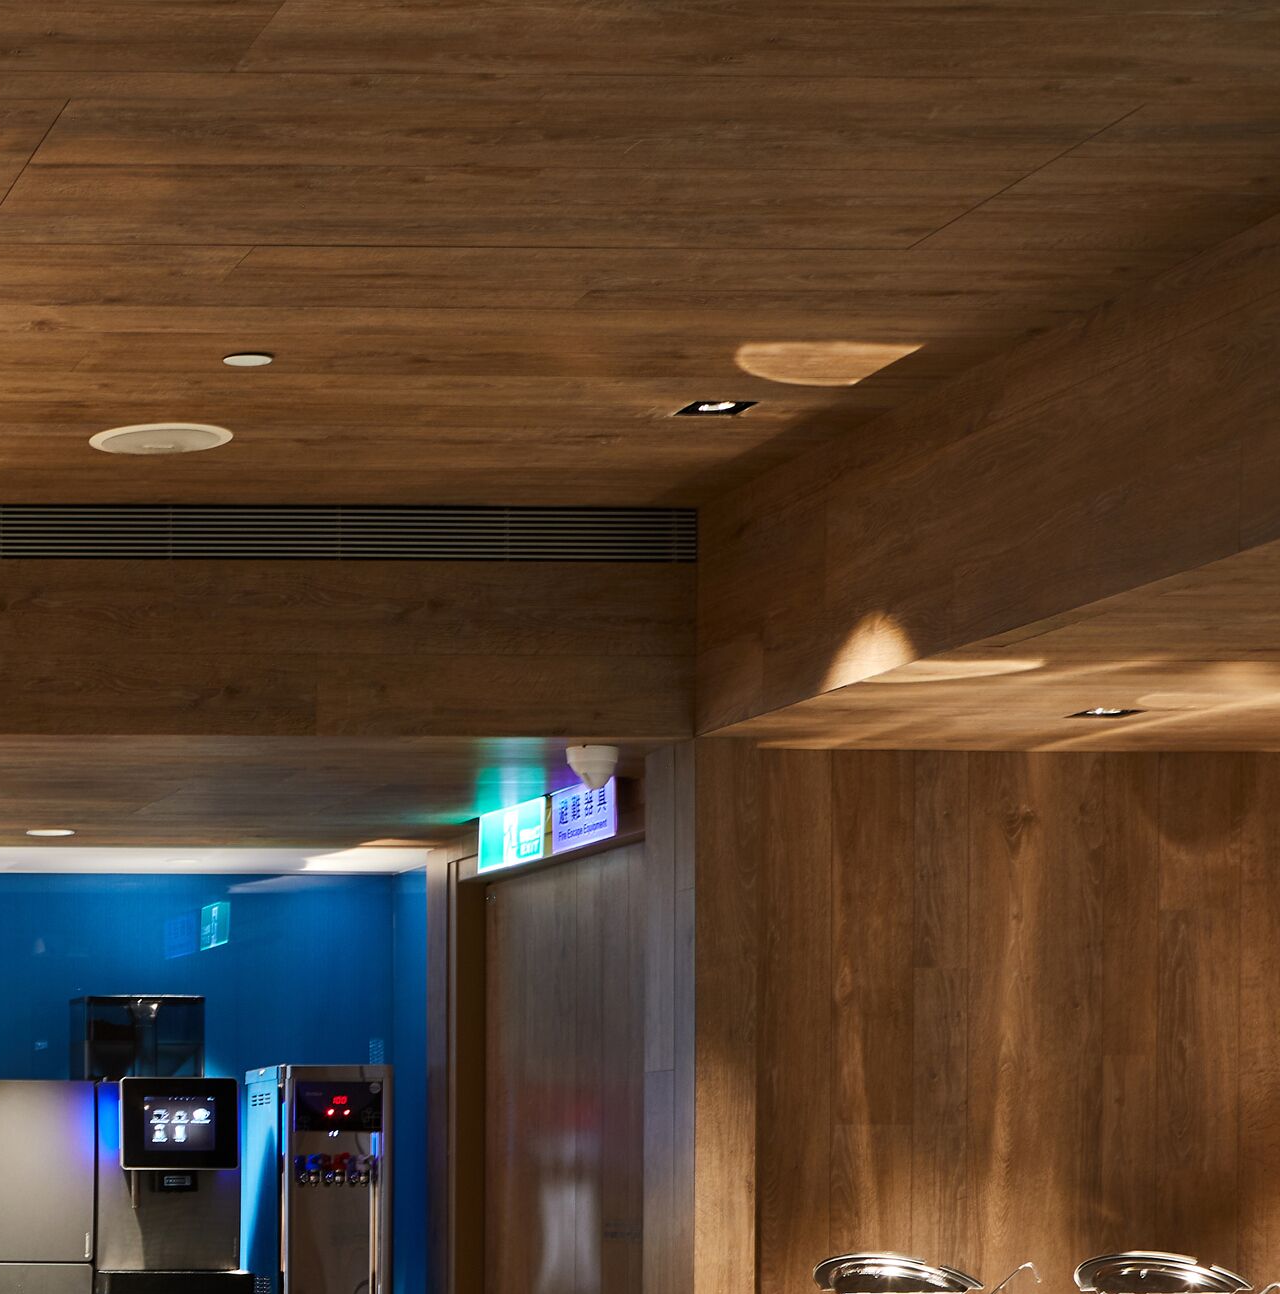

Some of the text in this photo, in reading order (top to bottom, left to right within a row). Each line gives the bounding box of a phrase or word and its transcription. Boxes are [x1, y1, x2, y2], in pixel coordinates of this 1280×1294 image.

[567, 827, 583, 839] Escape
[583, 819, 607, 834] Equipment
[520, 840, 540, 856] EXIT
